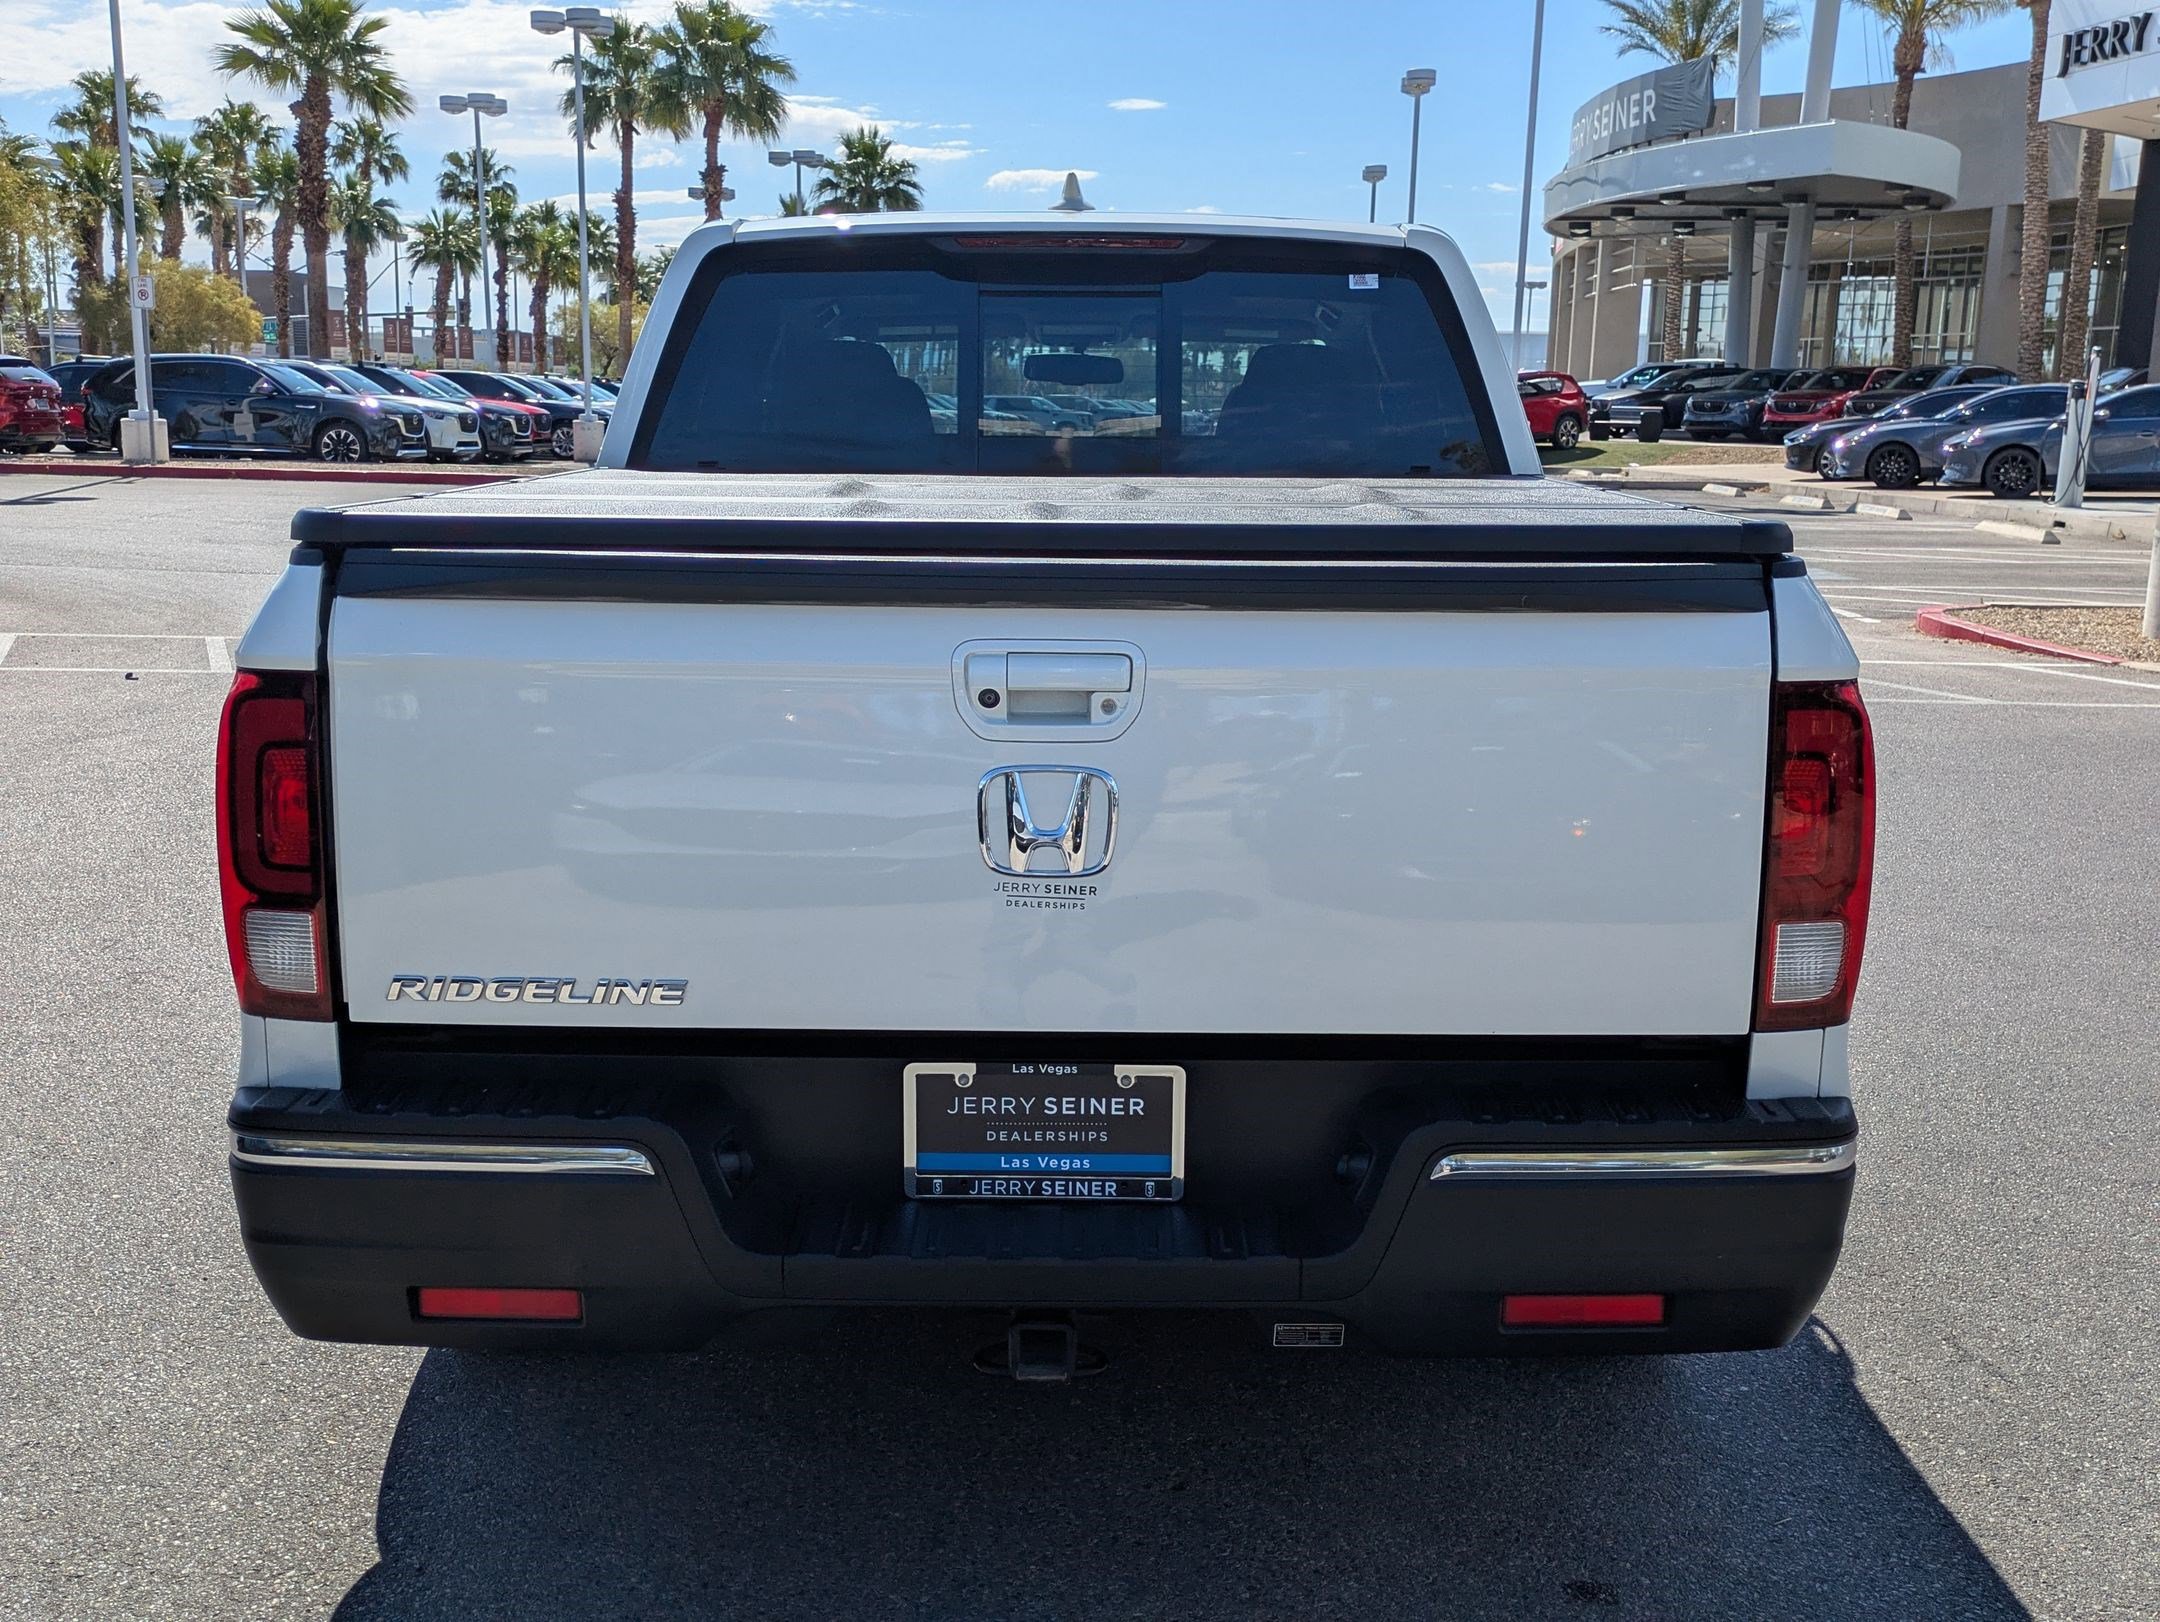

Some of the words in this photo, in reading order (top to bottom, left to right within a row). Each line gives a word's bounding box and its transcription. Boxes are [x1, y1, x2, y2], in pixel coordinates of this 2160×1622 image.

[2056, 12, 2153, 78] JERRY
[1592, 88, 1657, 141] SEINER
[993, 881, 1041, 893] JERRY
[1044, 883, 1098, 896] SEINER
[1006, 899, 1086, 910] DEALERSHIPS
[386, 975, 689, 1006] RIDGELINE
[1012, 1063, 1035, 1074] Las
[1038, 1064, 1078, 1076] Vegas
[946, 1096, 1036, 1115] JERRY
[1044, 1097, 1145, 1116] SEINER
[986, 1131, 1109, 1142] DEALERSHIPS
[1001, 1156, 1030, 1168] Las
[1037, 1157, 1091, 1171] Vegas
[969, 1180, 1036, 1195] JERRY
[1041, 1181, 1117, 1196] SEINER
